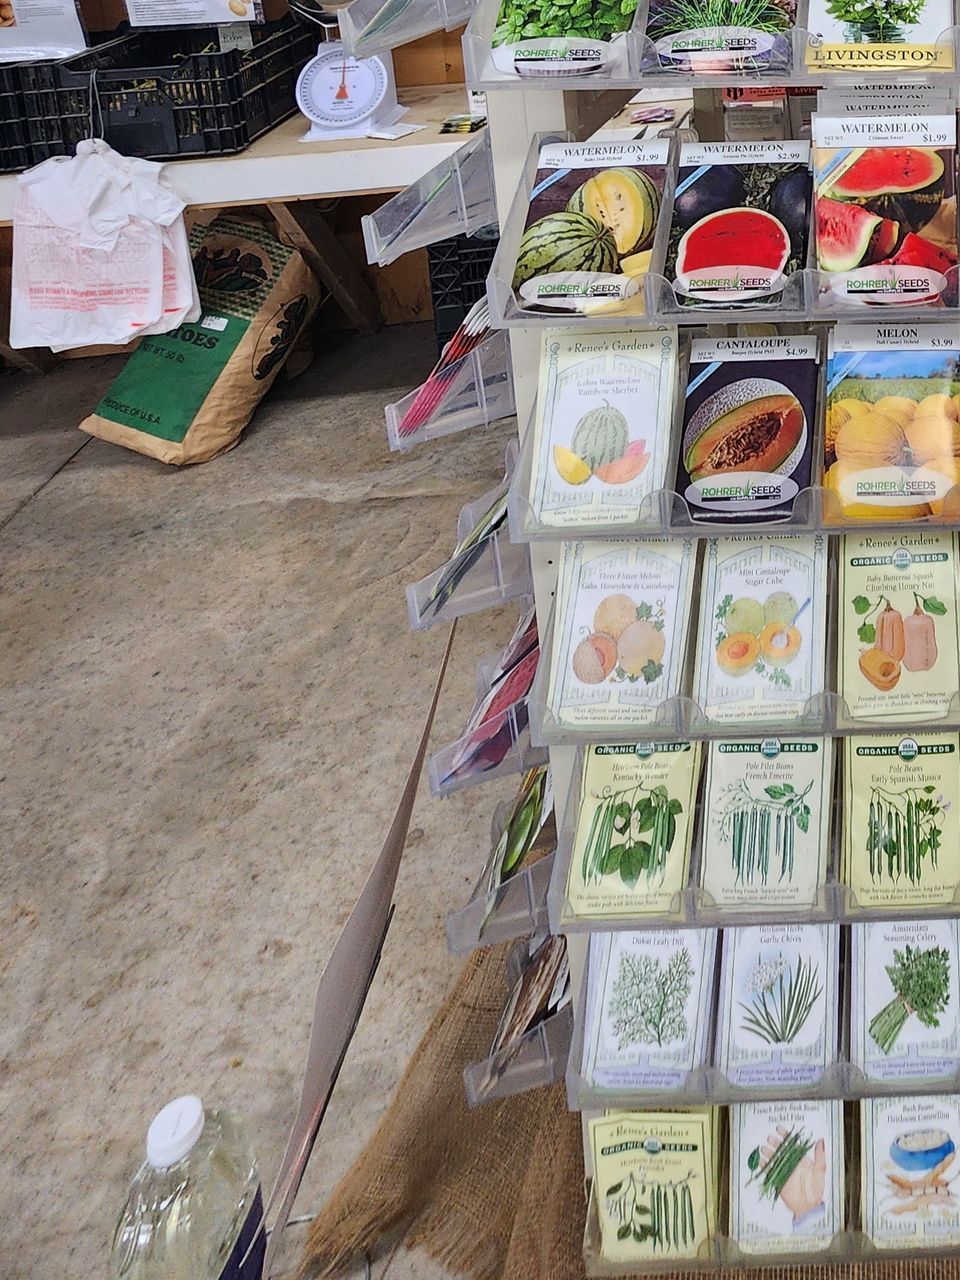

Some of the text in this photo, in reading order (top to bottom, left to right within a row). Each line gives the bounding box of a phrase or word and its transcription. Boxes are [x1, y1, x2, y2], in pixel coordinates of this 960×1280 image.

[671, 38, 757, 50] ROHRER SEEDS
[515, 48, 602, 58] ROHRER SEEDS
[814, 50, 938, 62] LIVINGSTON
[841, 122, 929, 134] WATERMELON
[923, 133, 947, 143] $1.99
[564, 144, 644, 158] WATERMELON
[703, 143, 784, 153] WATERMELON
[636, 153, 659, 162] $1.99
[777, 152, 800, 160] $2.99
[689, 277, 771, 288] ROHRER SEEDS
[847, 279, 930, 290] ROHRER SEEDS
[537, 283, 621, 294] ROHRER SEEDS
[876, 328, 918, 339] MELON
[573, 339, 648, 353] Renee's Garden
[716, 338, 791, 350] CANTALOUPE
[931, 338, 953, 348] $3.99
[786, 348, 808, 357] $4.99
[702, 485, 782, 497] ROHRER SEEDS
[857, 480, 936, 491] ROHRER SEEDS
[865, 534, 934, 548] Renee's Garden
[852, 554, 944, 567] ORGANIC SEEDS
[898, 582, 920, 592] Honey
[921, 581, 935, 590] Nut
[597, 745, 634, 754] ORGANIC
[720, 744, 813, 752] ORGANIC SEEDS
[920, 745, 950, 753] SEEDS
[914, 933, 937, 943] Celery
